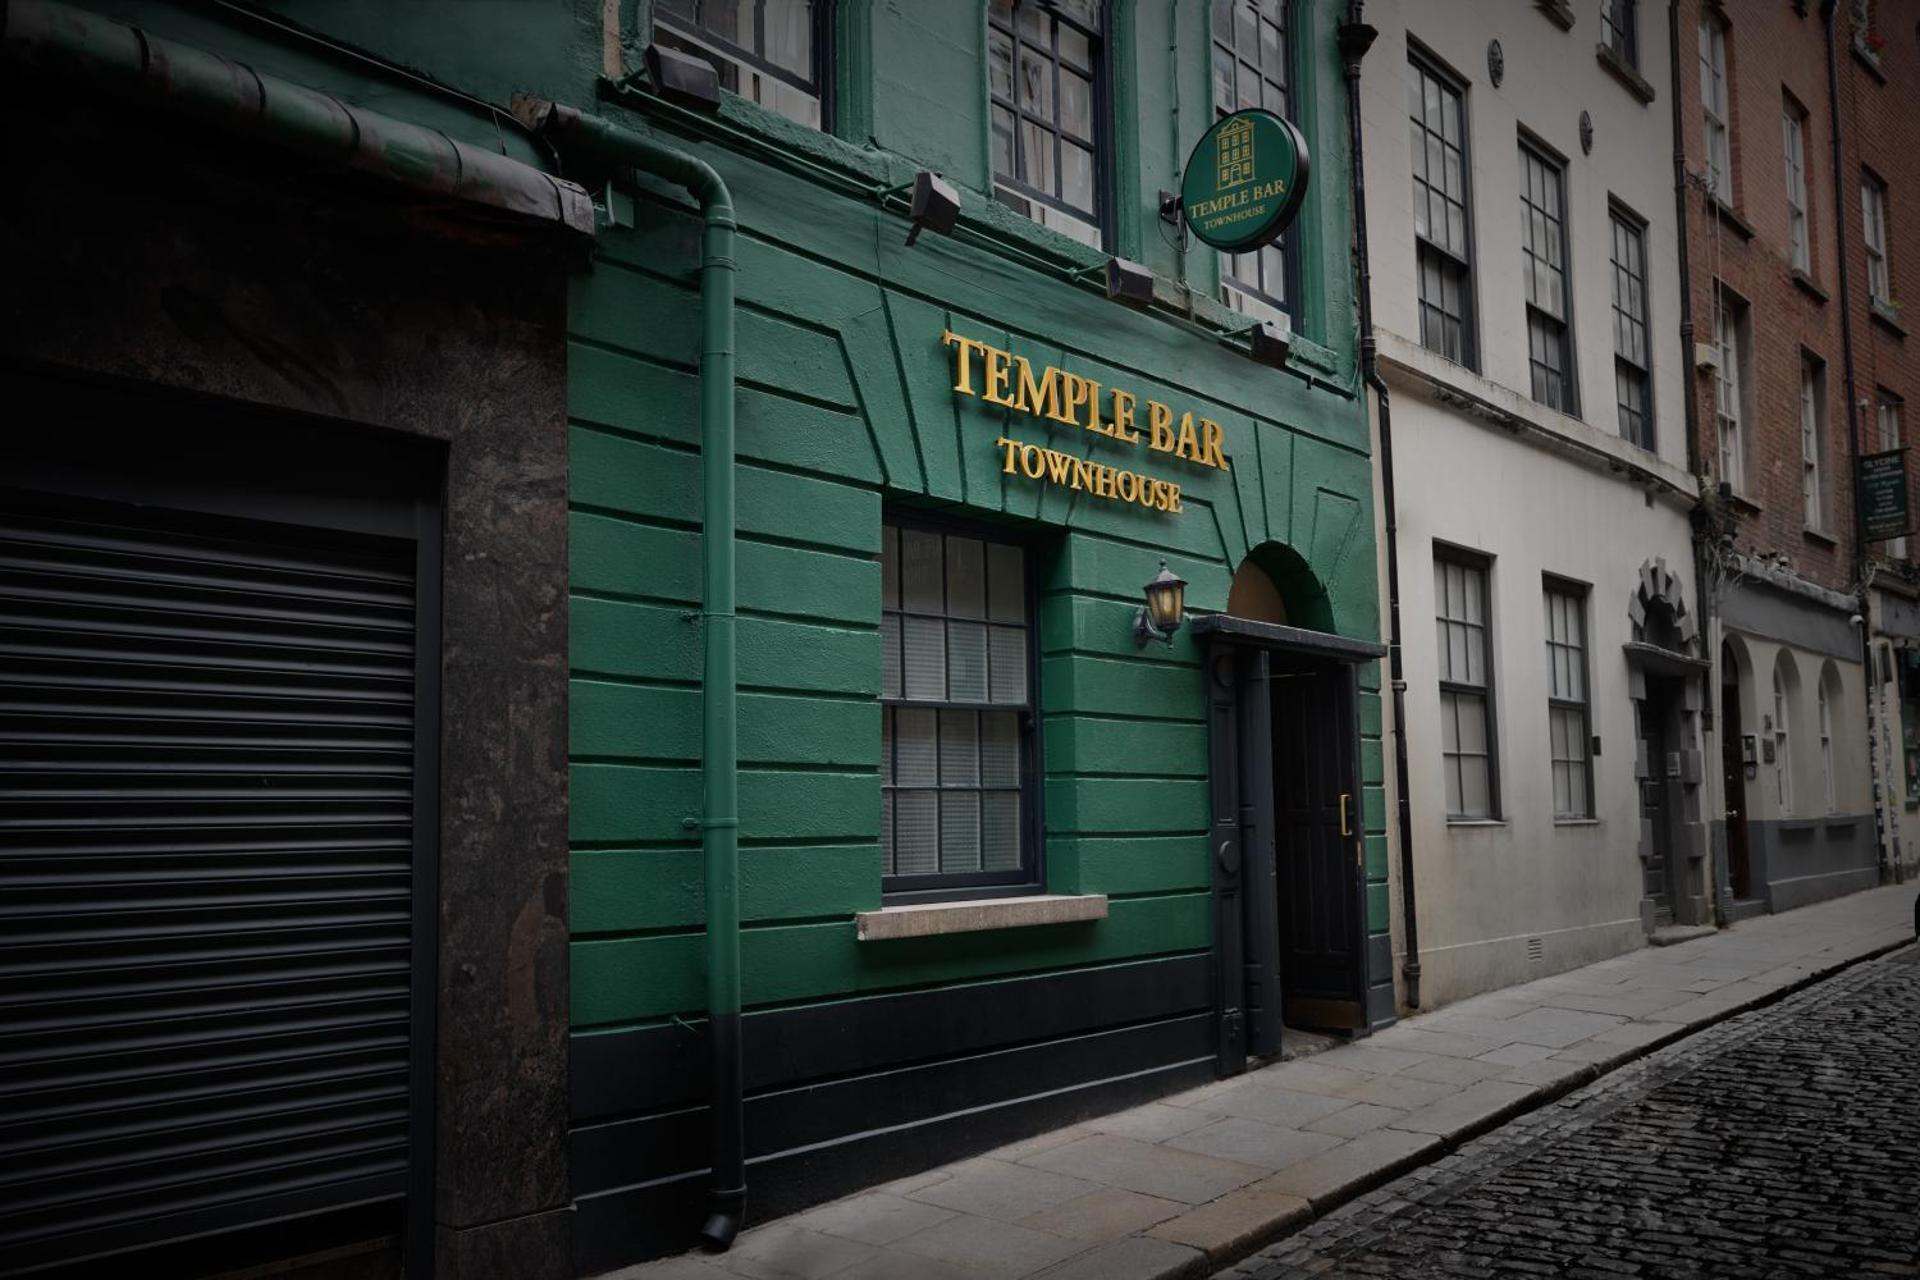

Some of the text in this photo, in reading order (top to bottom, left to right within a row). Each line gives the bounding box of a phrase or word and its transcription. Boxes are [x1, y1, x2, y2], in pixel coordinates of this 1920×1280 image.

[1190, 179, 1285, 219] TEMPLE BAR
[1203, 204, 1265, 230] TOWNHOUSE
[941, 328, 1231, 472] TEMPLE BAR
[996, 436, 1183, 513] TOWNHOUSE
